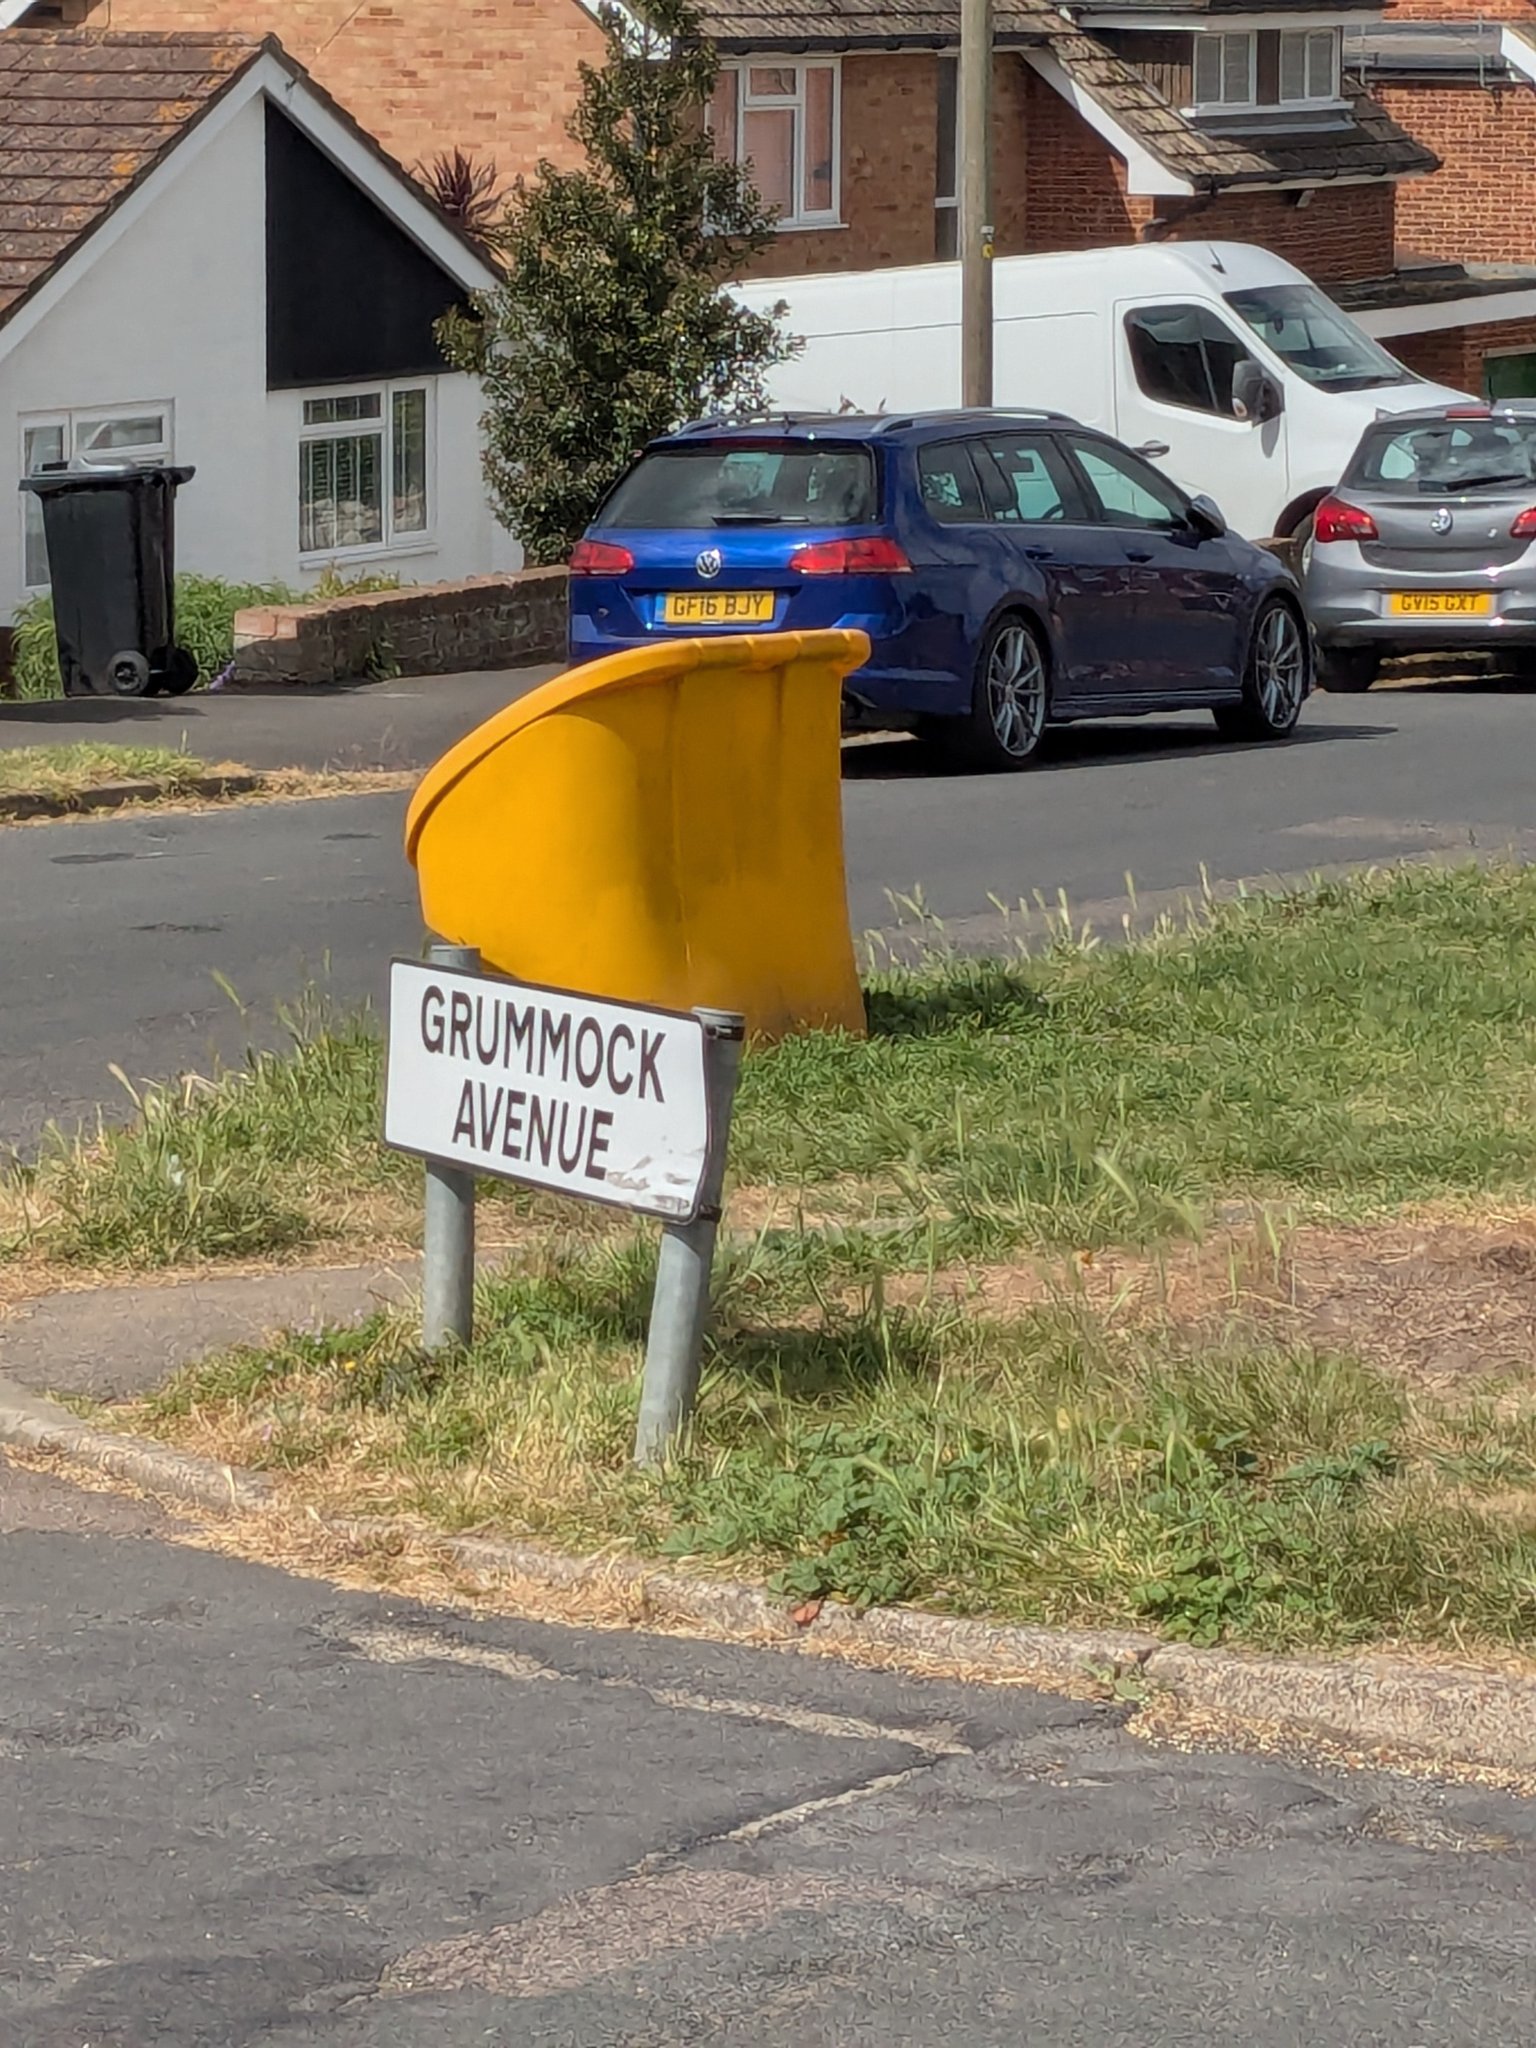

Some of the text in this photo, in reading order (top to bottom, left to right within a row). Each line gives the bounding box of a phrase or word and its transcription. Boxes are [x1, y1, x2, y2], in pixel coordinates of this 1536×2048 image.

[673, 594, 765, 617] GF16 BJY
[1401, 594, 1479, 611] GV15 GXT
[421, 985, 667, 1104] GRUMMOCK
[452, 1079, 615, 1181] AVENUE
